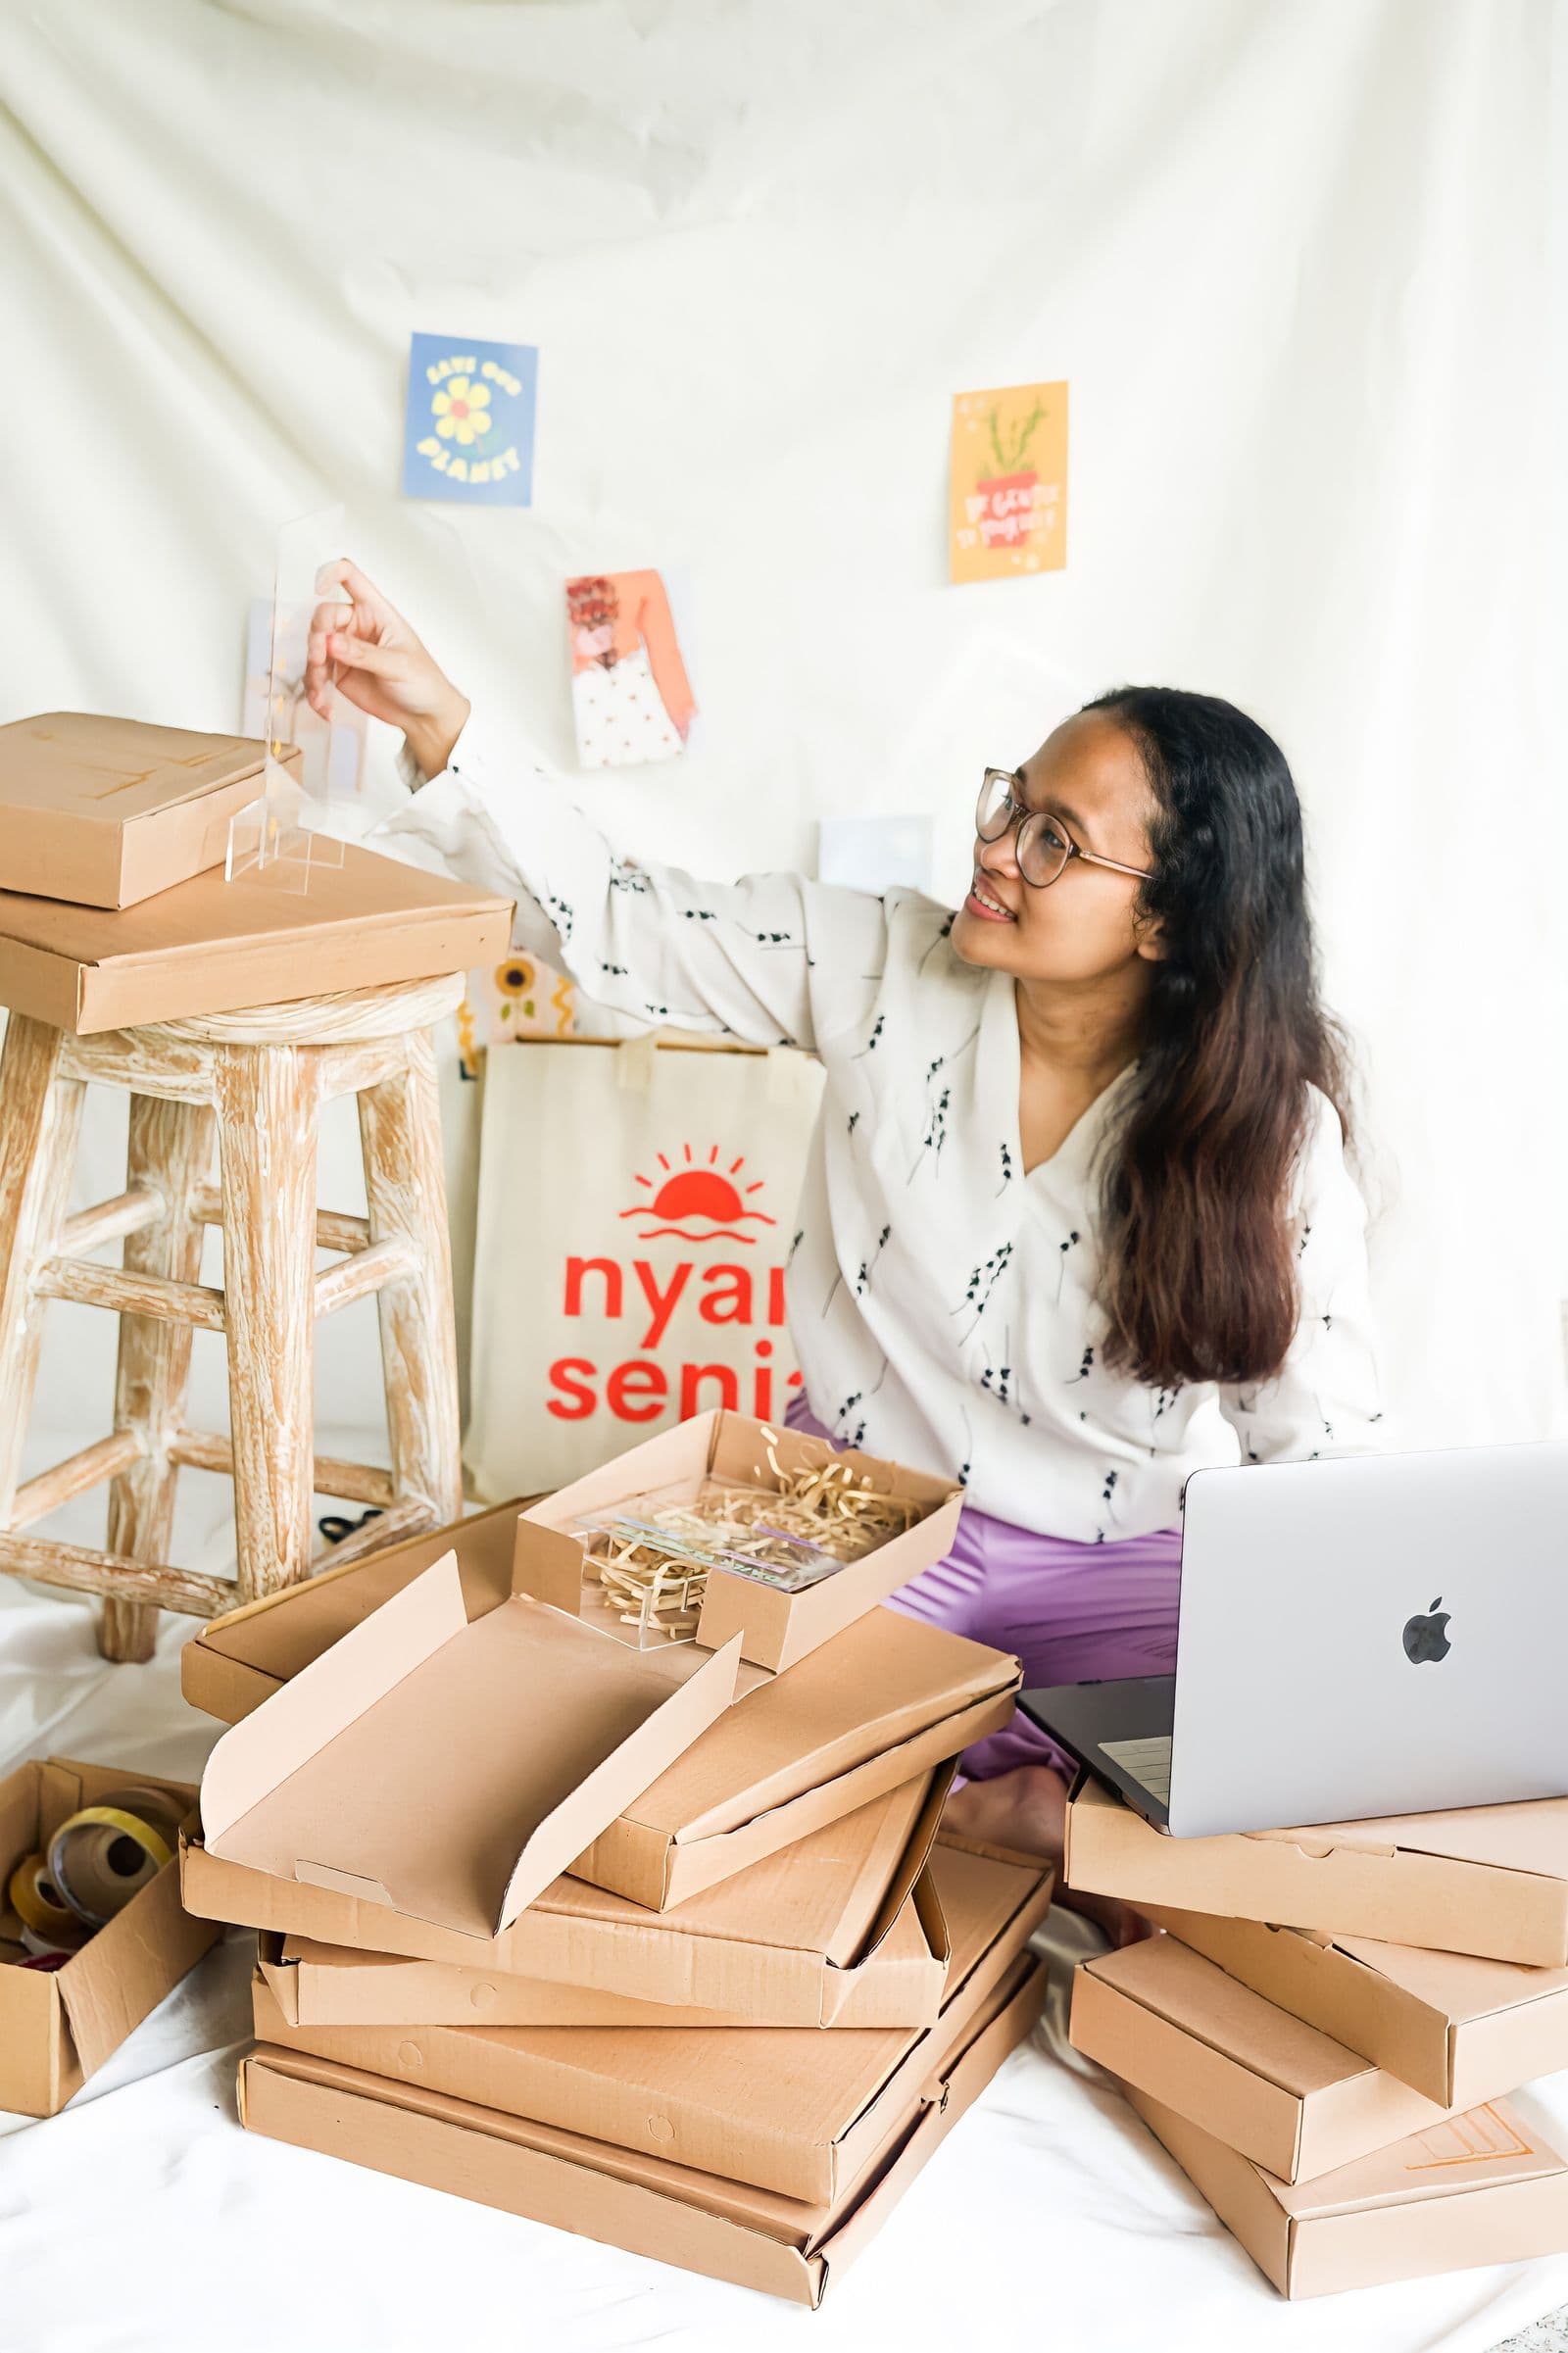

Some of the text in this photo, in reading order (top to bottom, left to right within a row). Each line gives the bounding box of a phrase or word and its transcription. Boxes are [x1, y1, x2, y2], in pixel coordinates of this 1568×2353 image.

[416, 436, 520, 484] PLANET
[564, 1255, 784, 1349] nya
[546, 1339, 804, 1423] seni
